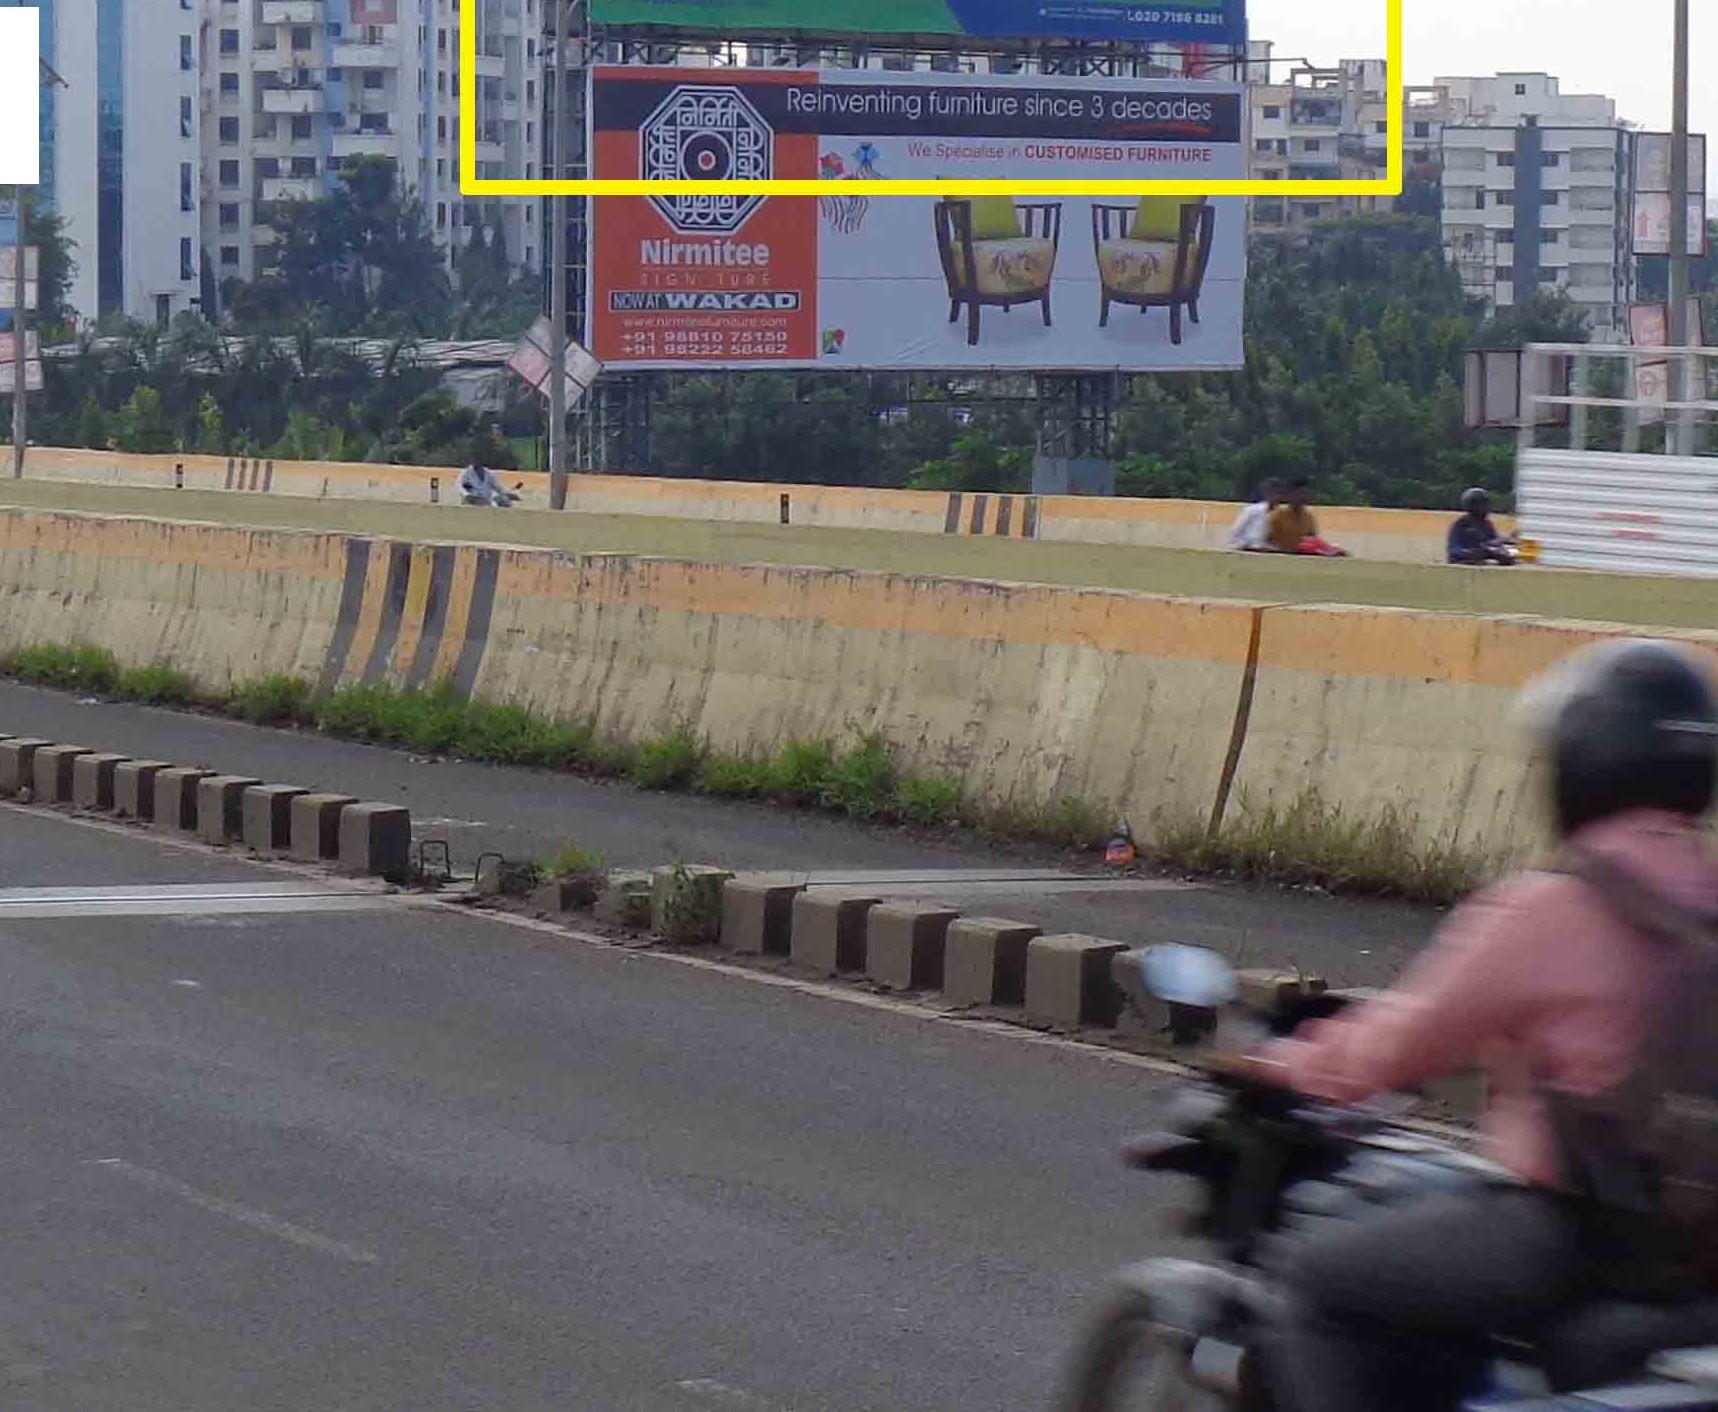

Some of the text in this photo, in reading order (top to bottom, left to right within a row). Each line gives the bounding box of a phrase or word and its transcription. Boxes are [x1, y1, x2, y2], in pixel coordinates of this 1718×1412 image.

[787, 88, 1212, 121] Reinventing furniture since 3 decades
[907, 143, 1212, 162] We Specialise in CUSTOMISED FURNITURE
[640, 239, 771, 267] Nirmitee
[613, 292, 644, 309] NOW
[665, 292, 797, 310] WAKAD
[620, 331, 656, 343] +91
[620, 343, 656, 356] +91
